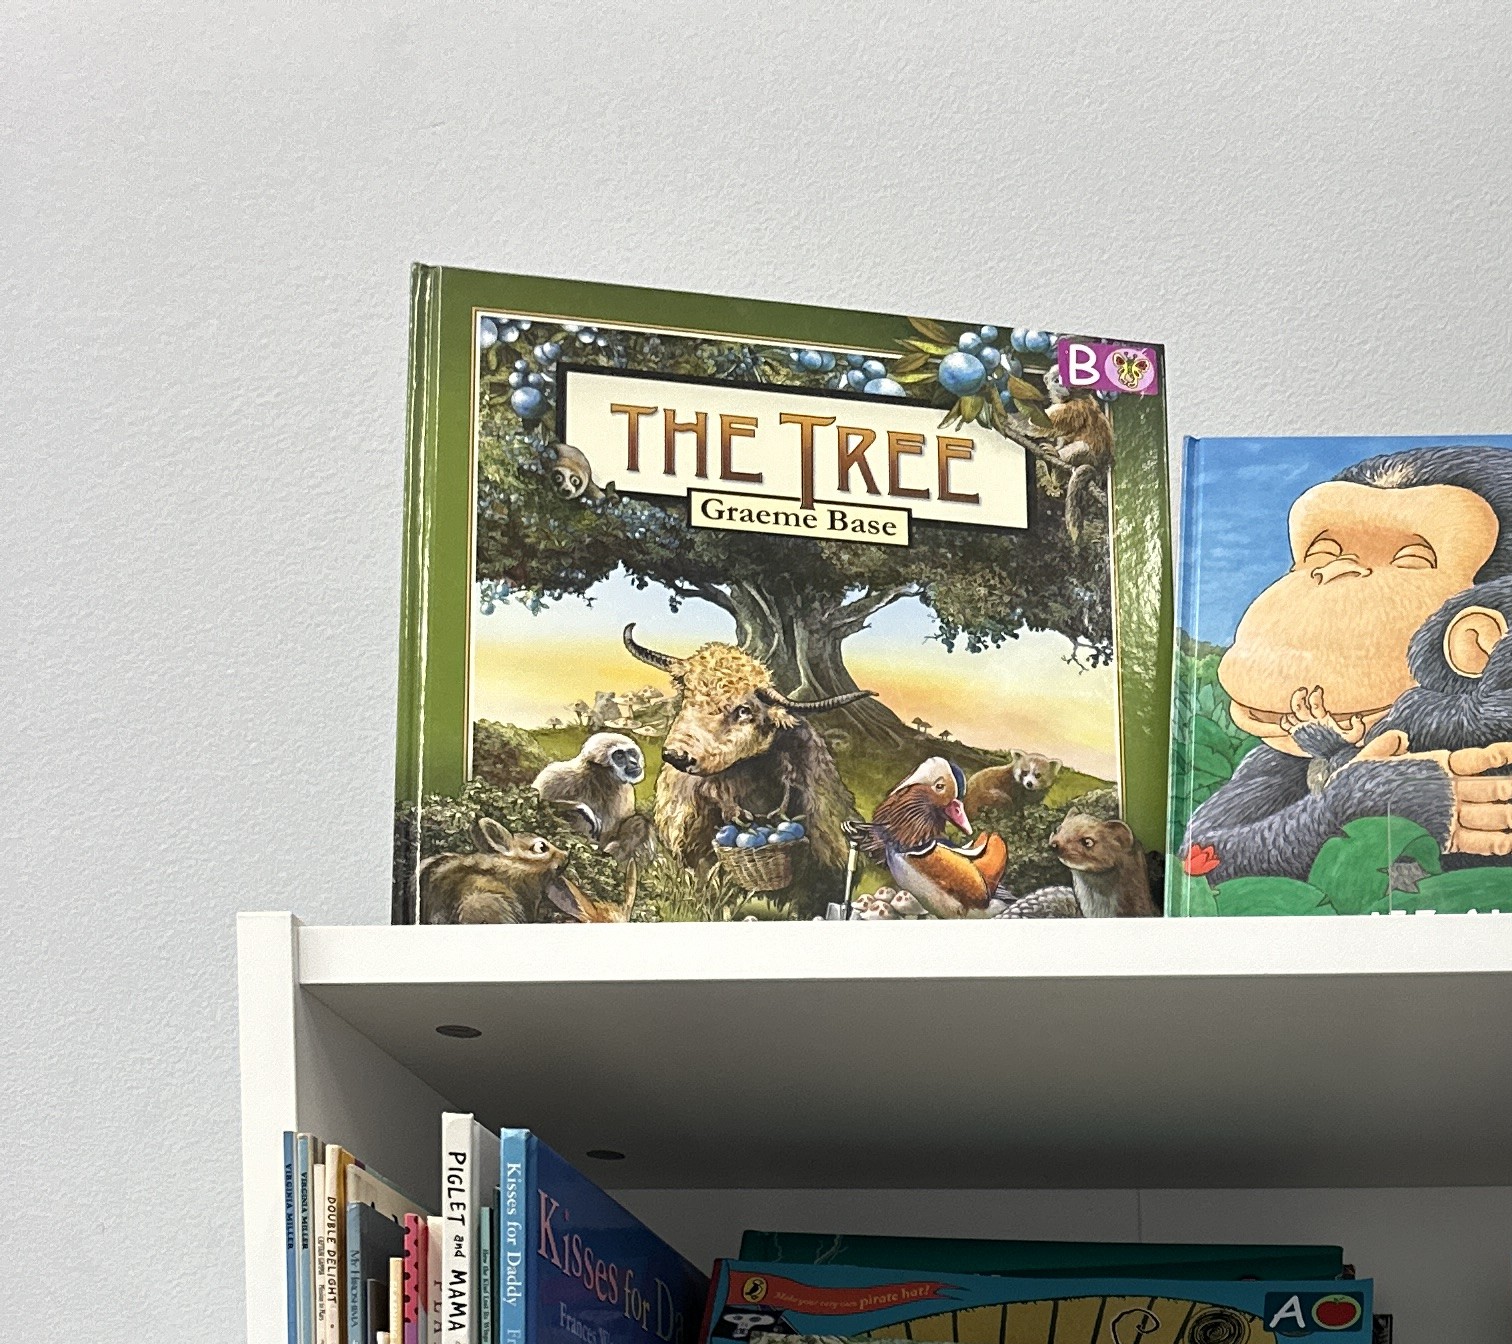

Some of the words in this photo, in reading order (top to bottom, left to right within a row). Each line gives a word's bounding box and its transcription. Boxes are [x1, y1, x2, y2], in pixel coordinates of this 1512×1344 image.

[1068, 345, 1100, 387] B
[610, 403, 763, 483] THE
[779, 412, 980, 509] TREE
[700, 498, 818, 530] Graeme
[826, 507, 898, 537] Base
[447, 1152, 467, 1226] PIGLET
[506, 1162, 522, 1215] Kisses
[327, 1197, 337, 1243] DOUBLE
[454, 1234, 466, 1258] and
[506, 1221, 522, 1245] for
[326, 1250, 337, 1303] DELIGHT
[503, 1251, 523, 1307] Daddy
[537, 1189, 618, 1304] Kisses
[623, 1268, 650, 1332] for
[448, 1269, 467, 1331] MAMA
[1271, 1296, 1307, 1329] A
